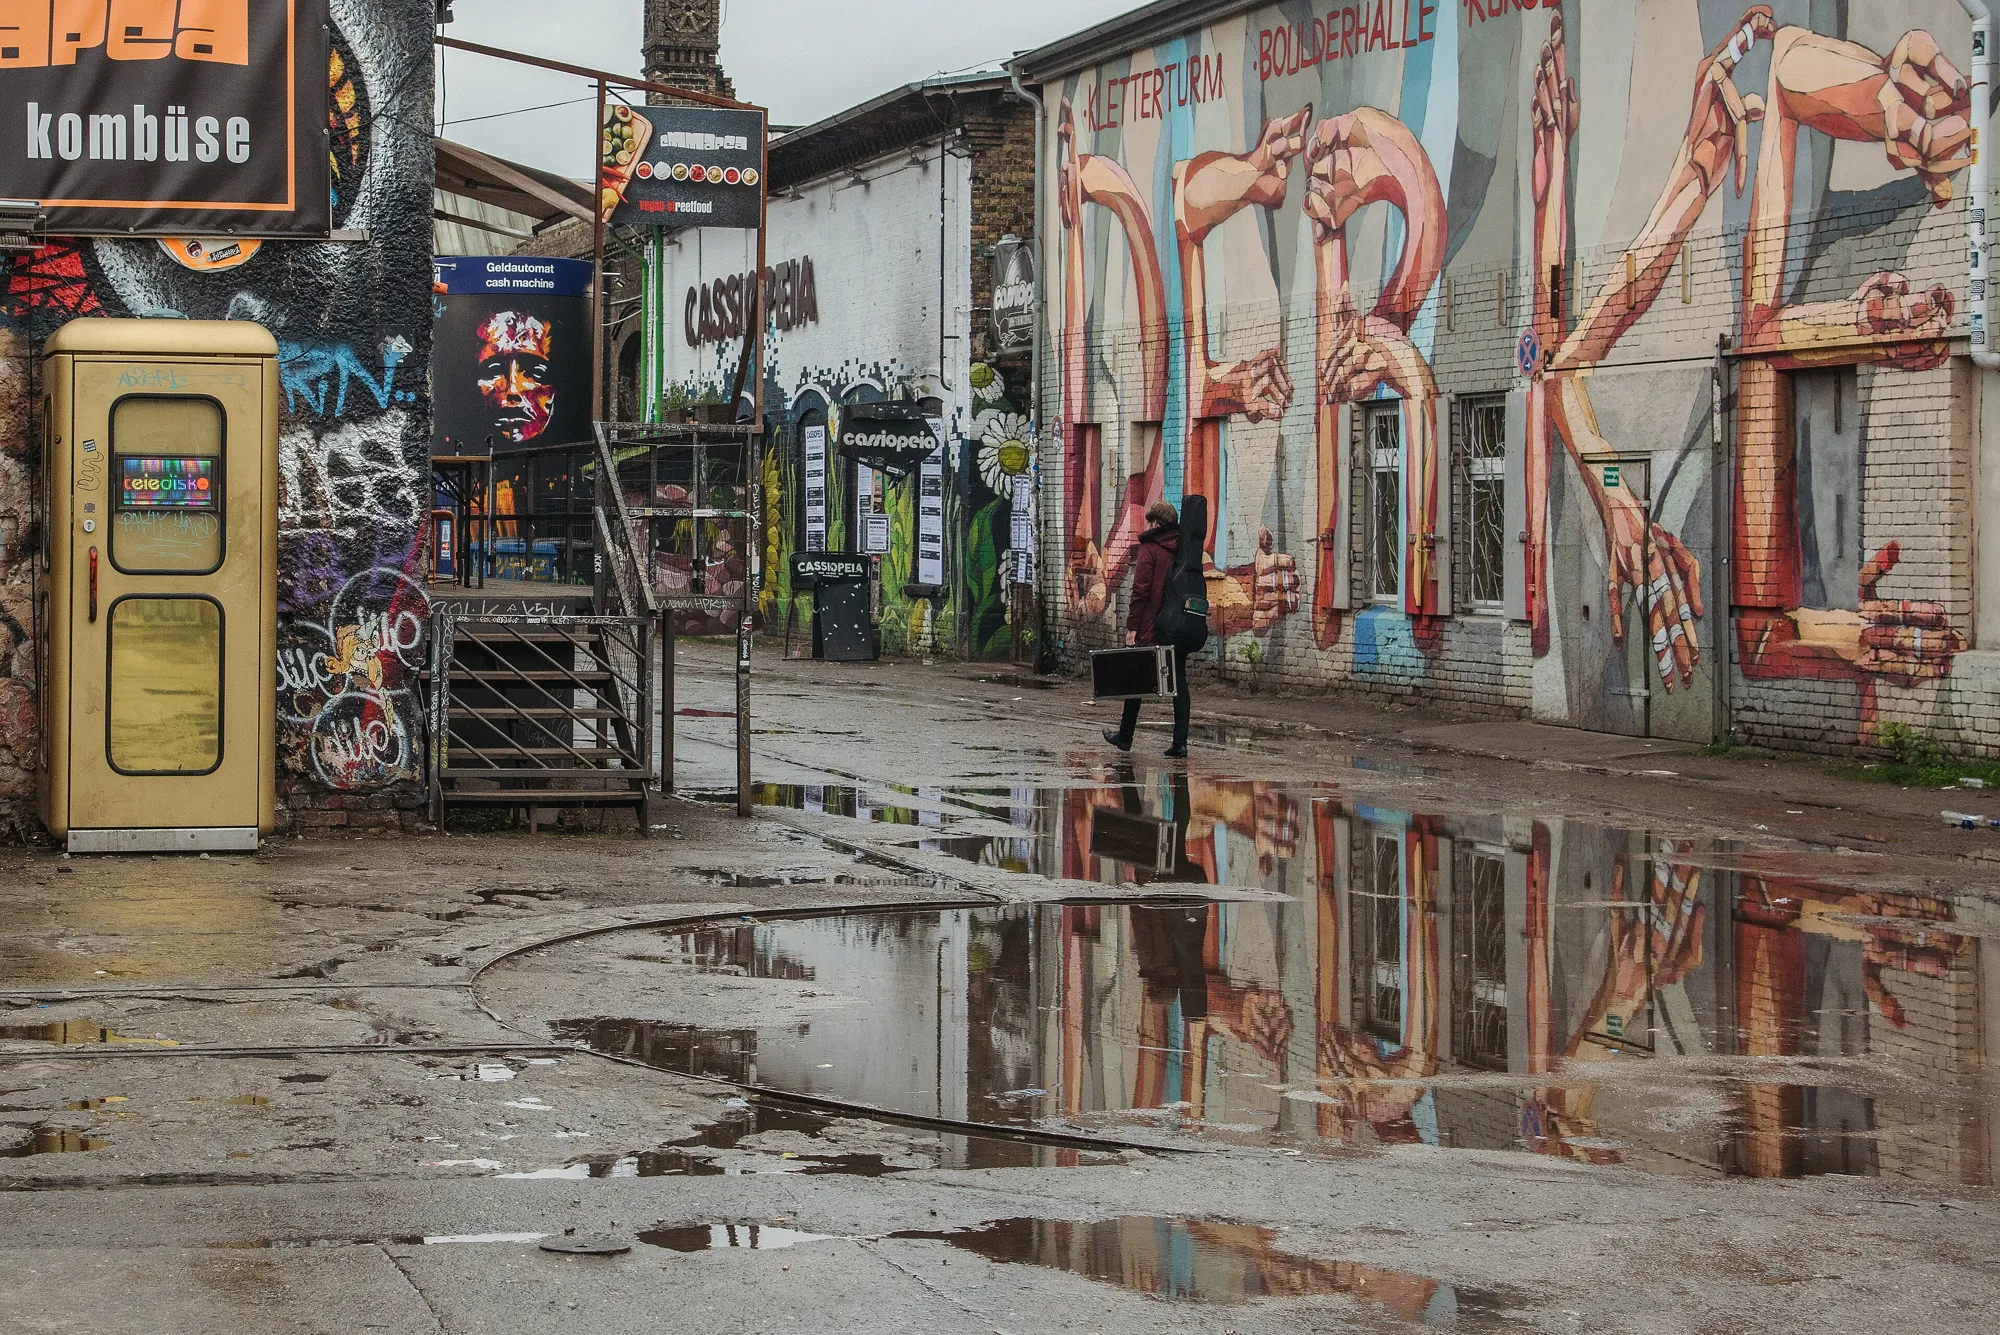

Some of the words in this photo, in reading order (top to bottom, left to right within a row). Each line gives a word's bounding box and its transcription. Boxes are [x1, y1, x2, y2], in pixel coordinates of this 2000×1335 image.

[27, 102, 250, 164] kombüse
[486, 262, 555, 274] Geldautomat
[485, 277, 511, 288] cash
[512, 278, 555, 289] machine
[842, 429, 936, 452] cassiopeia
[797, 561, 864, 574] CASSIOPEIA
